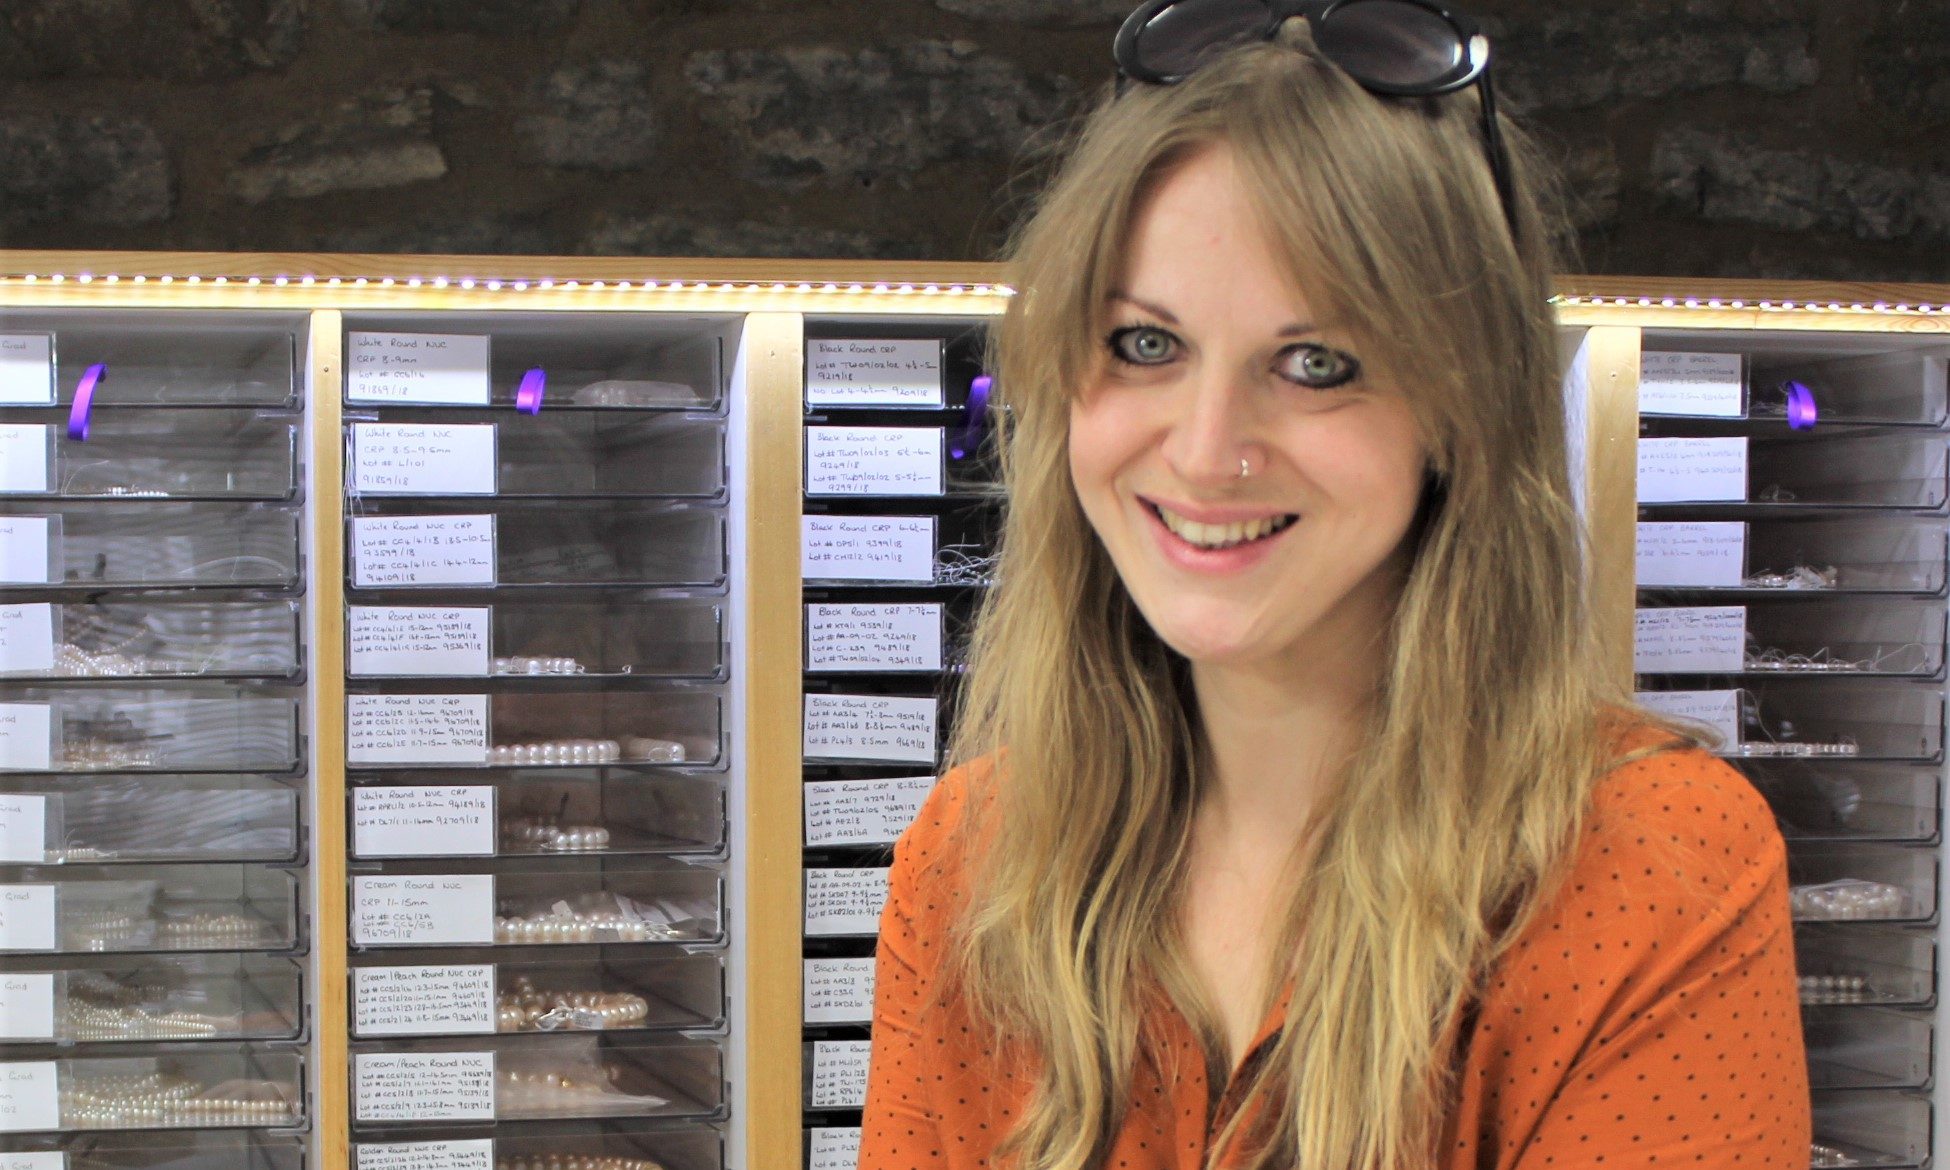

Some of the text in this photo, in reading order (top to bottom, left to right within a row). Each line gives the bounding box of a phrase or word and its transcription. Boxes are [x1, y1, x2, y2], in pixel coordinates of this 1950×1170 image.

[358, 337, 383, 347] White
[391, 338, 417, 347] Round
[819, 342, 843, 353] Black
[850, 343, 876, 353] Round
[365, 428, 391, 437] White
[398, 428, 424, 437] Round
[847, 432, 876, 441] Round
[364, 521, 387, 530] White
[393, 521, 419, 530] Round
[840, 522, 867, 532] Round
[357, 611, 378, 621] White
[388, 610, 413, 620] Round
[851, 606, 876, 616] Round
[385, 697, 410, 705] Round
[842, 699, 867, 708] Round
[842, 784, 869, 792] Round
[389, 790, 414, 799] Round
[834, 870, 854, 878] Round
[365, 882, 397, 890] Cream
[405, 880, 435, 889] Round
[814, 963, 868, 972] Black Round
[421, 969, 444, 978] Round
[430, 1059, 457, 1067] Round
